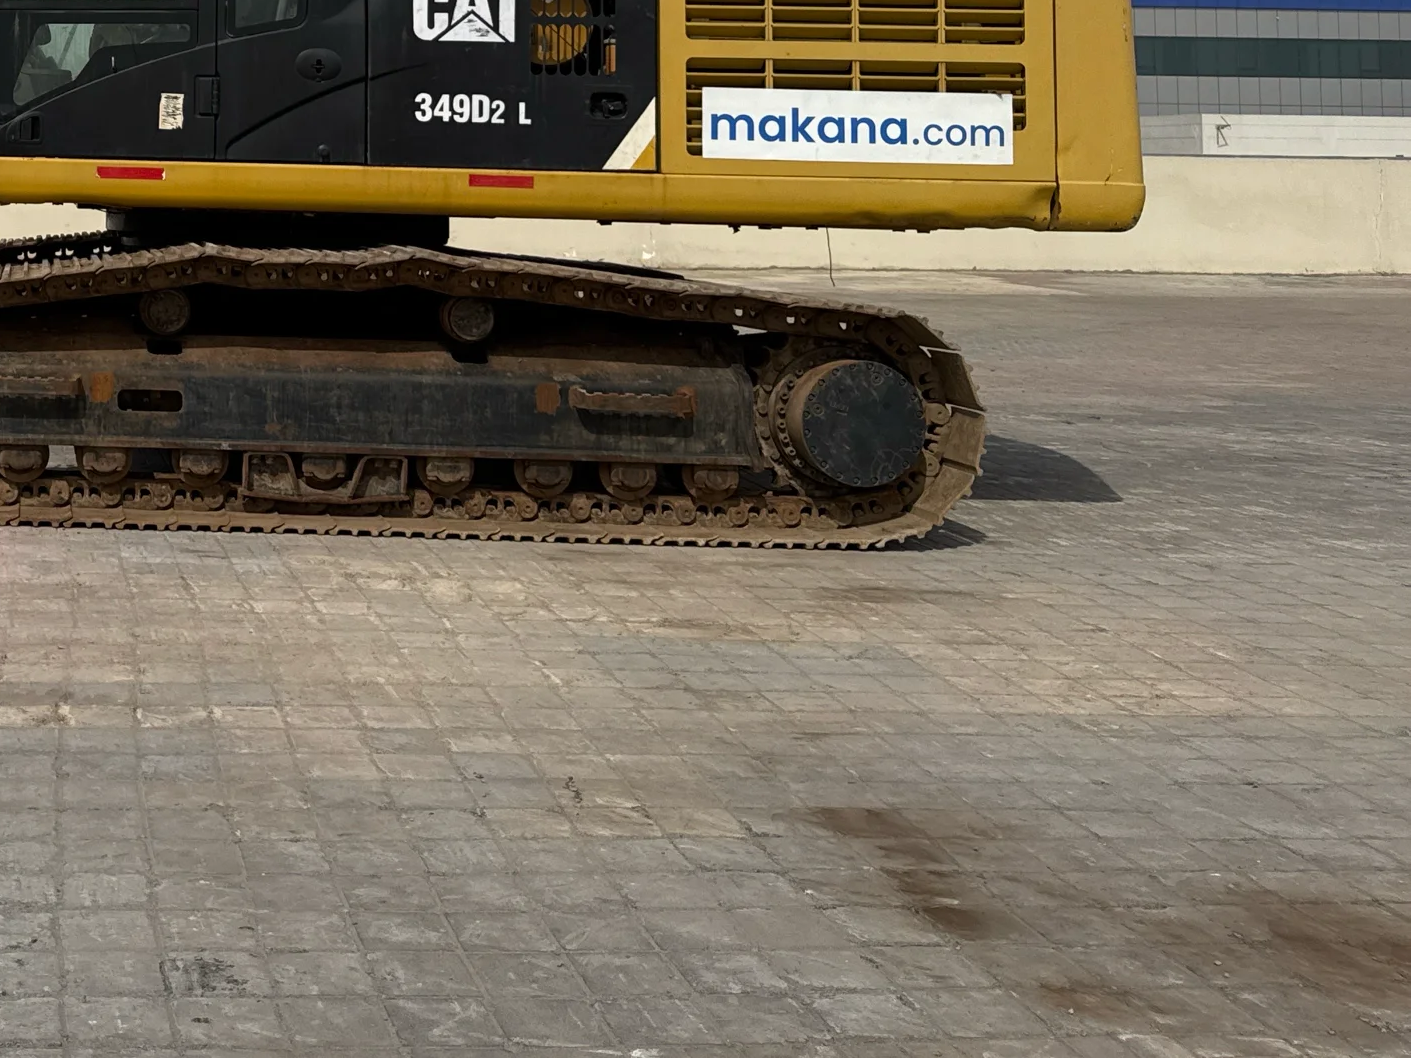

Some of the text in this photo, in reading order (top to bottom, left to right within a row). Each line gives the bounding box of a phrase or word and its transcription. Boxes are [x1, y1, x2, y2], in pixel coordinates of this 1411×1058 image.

[414, 92, 531, 124] 349D2 L
[710, 107, 1006, 146] makana.com
